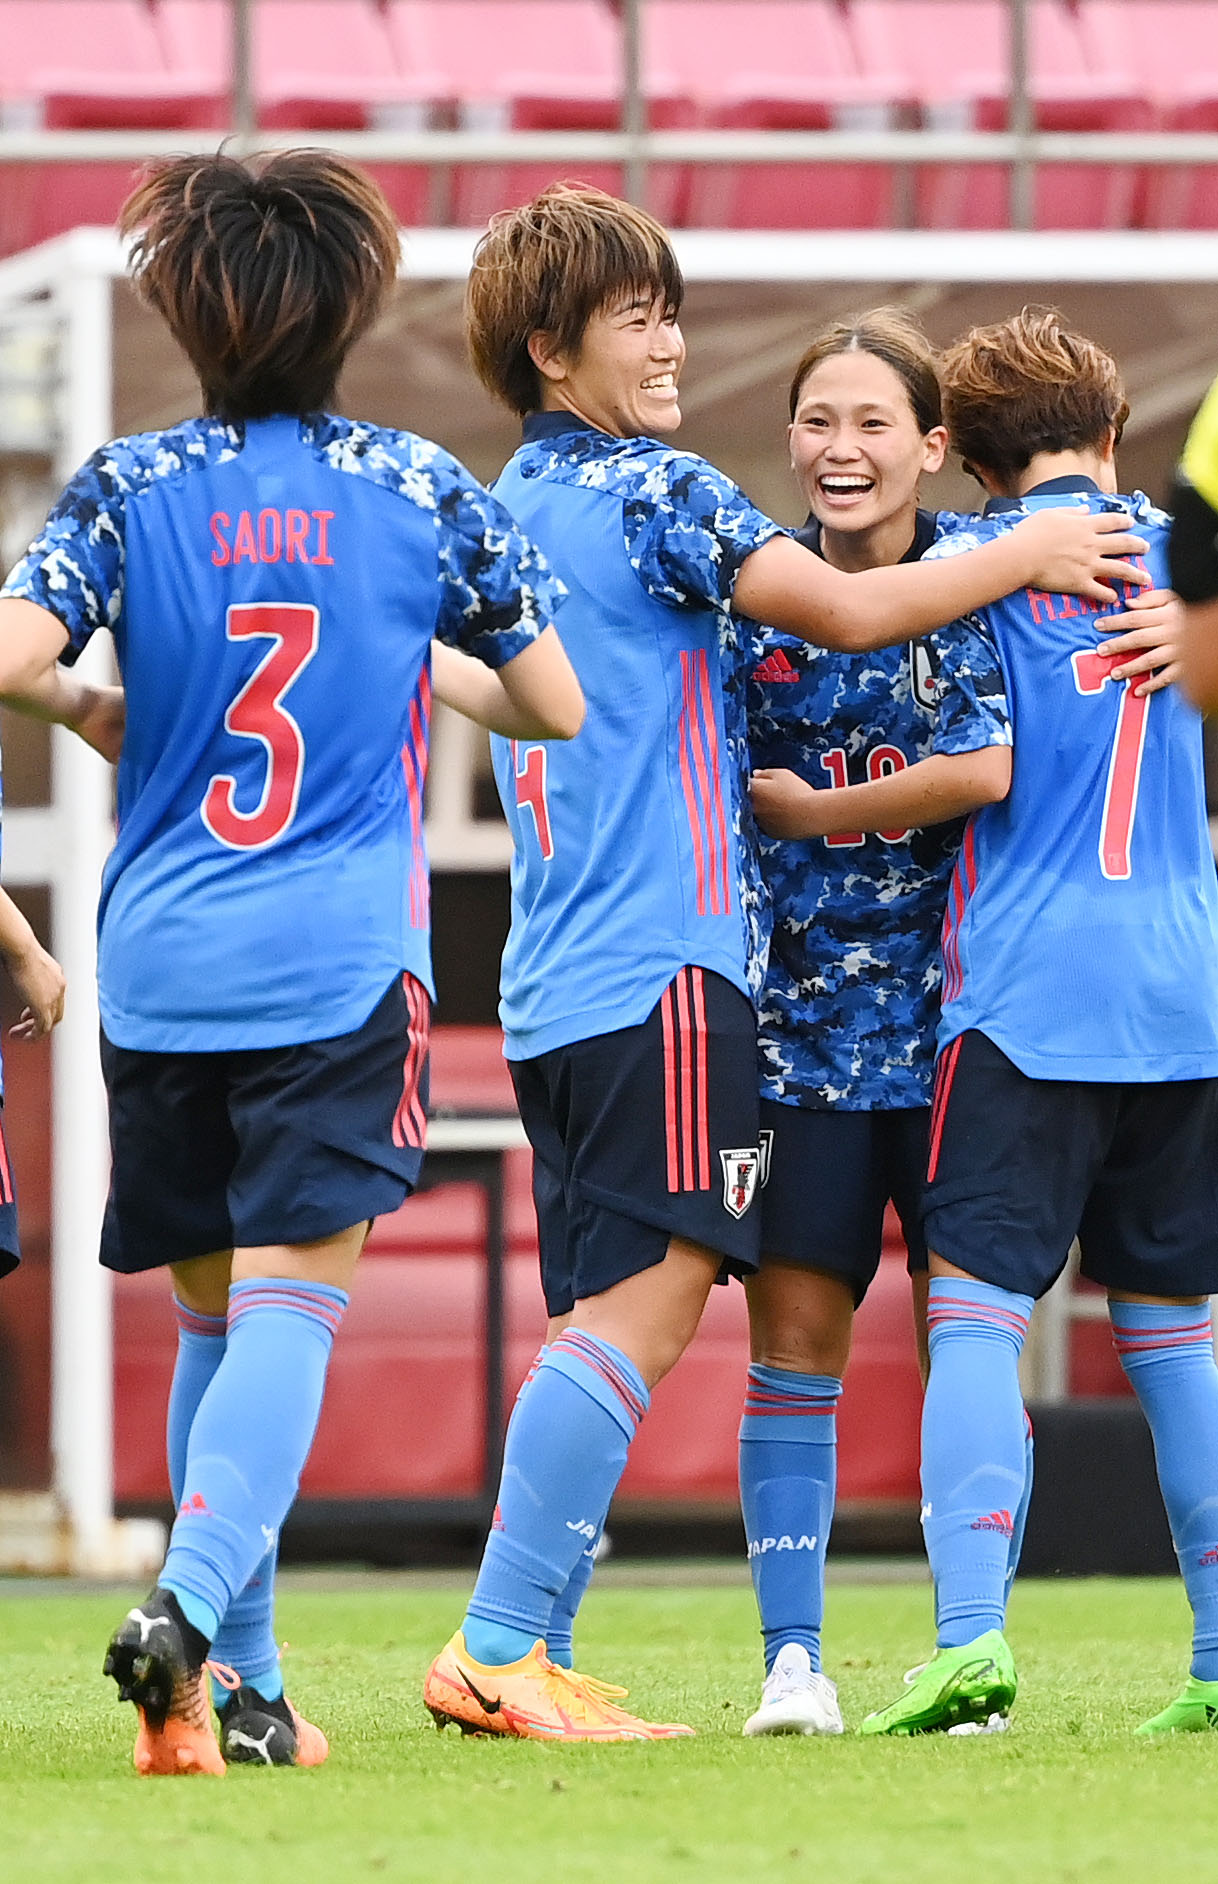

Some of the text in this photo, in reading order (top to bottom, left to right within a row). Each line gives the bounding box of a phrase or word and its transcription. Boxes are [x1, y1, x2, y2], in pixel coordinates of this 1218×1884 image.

[210, 508, 335, 566] SAORI
[200, 602, 320, 851] 3
[1070, 648, 1153, 881] 7
[510, 739, 554, 861] 4
[747, 1535, 817, 1560] JAPAN
